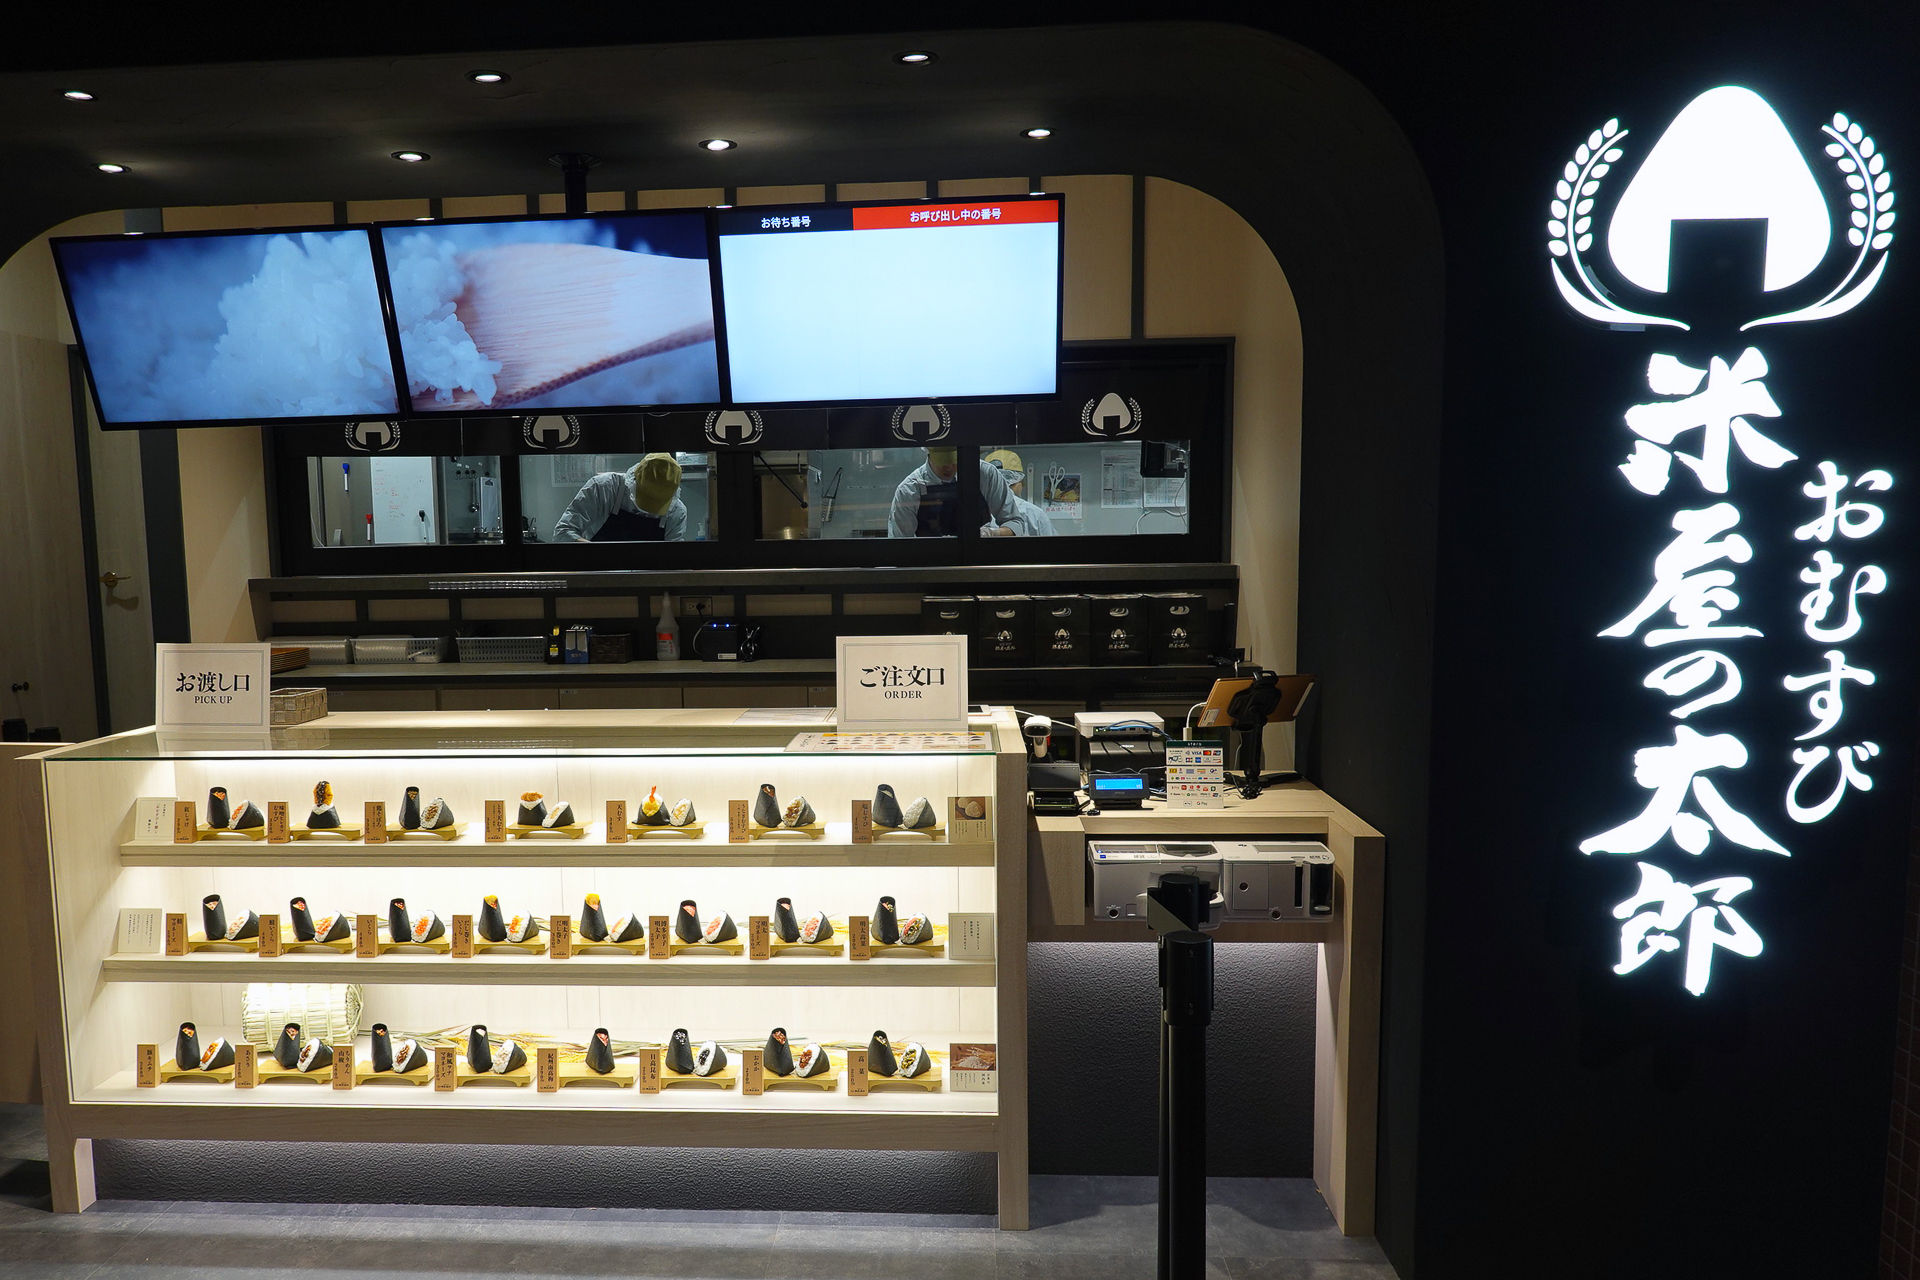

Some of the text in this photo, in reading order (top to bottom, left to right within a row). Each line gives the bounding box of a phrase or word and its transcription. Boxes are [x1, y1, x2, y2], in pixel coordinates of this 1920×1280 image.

[761, 215, 811, 229] お待ち番号
[910, 208, 1001, 223] お呼び出し中の番号
[1784, 460, 1894, 824] おむすび
[860, 665, 945, 688] ご注文口
[1579, 346, 1799, 997] 米屋の太郎
[176, 672, 250, 693] お渡し口
[194, 695, 233, 704] PICK UP
[884, 690, 923, 700] ORDER
[761, 921, 767, 933] 明太
